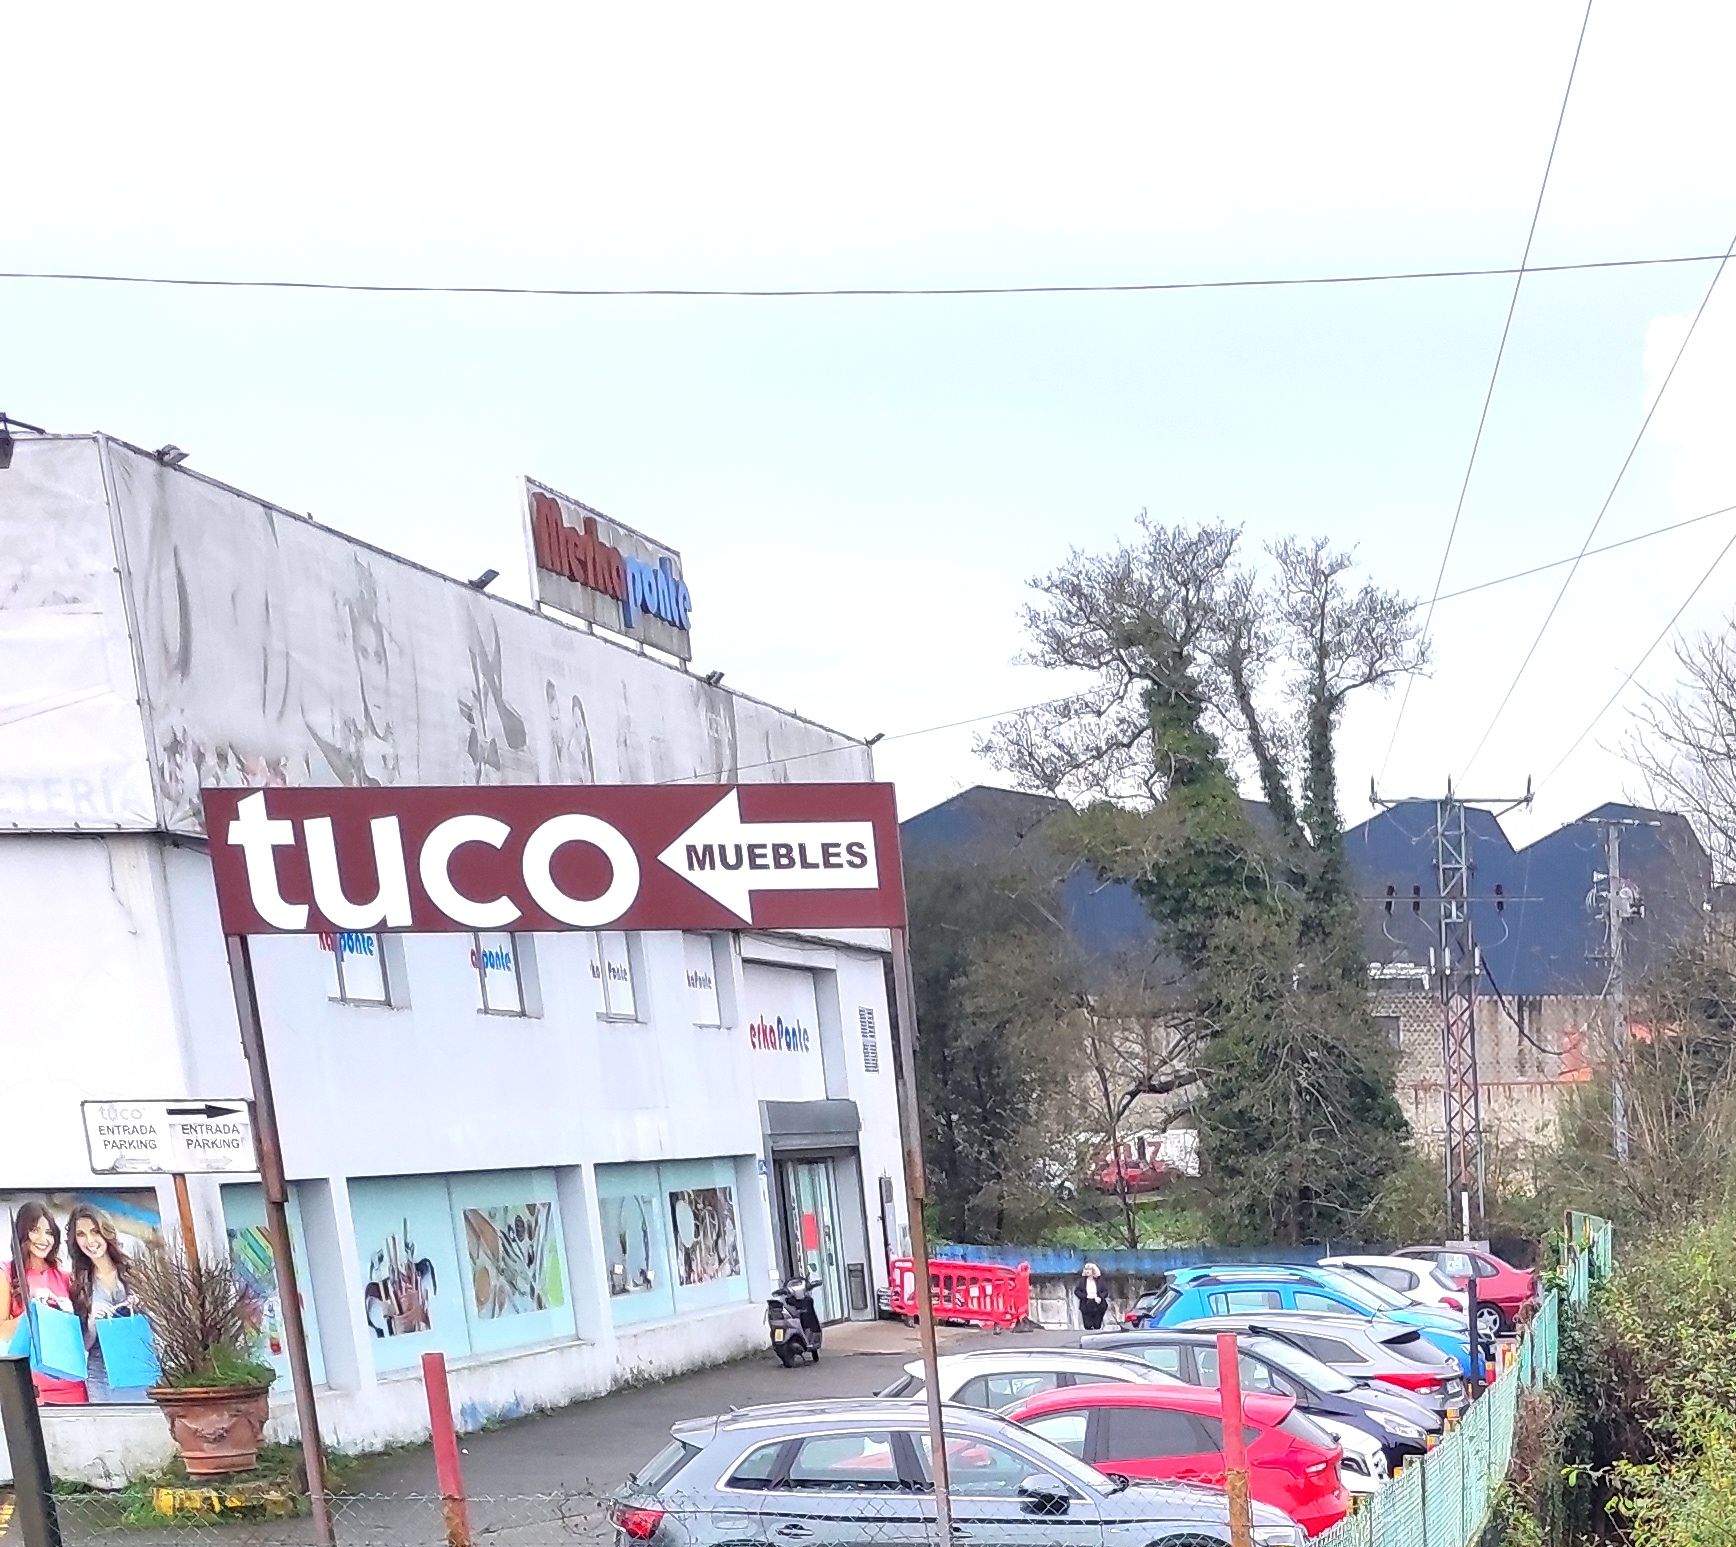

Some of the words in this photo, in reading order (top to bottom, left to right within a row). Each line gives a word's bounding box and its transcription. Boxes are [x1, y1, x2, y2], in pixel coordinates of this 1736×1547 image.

[227, 790, 641, 929] tuco
[685, 841, 868, 872] MUEBLES
[98, 1125, 157, 1136] ENTRADA
[181, 1123, 241, 1135] ENTRADA
[103, 1139, 158, 1150] PARKING
[186, 1138, 240, 1150] PARKING
